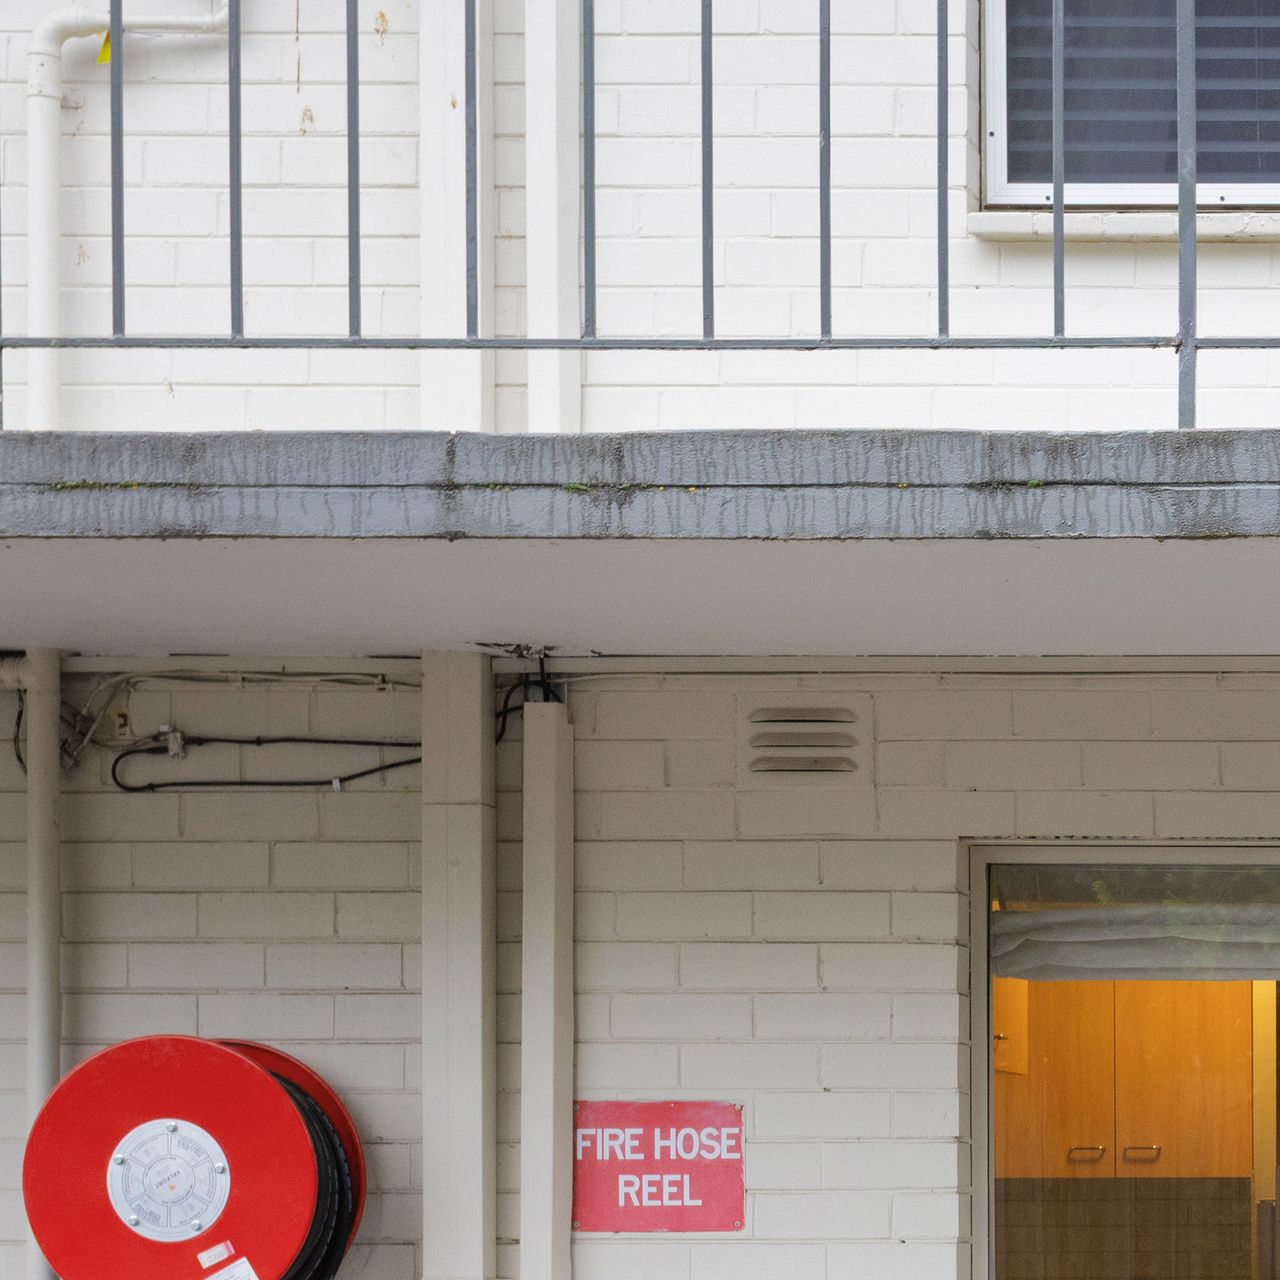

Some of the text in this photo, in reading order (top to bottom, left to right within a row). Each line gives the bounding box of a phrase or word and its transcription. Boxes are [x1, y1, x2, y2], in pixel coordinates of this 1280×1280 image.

[576, 1127, 740, 1160] FIRE HOSE
[618, 1174, 702, 1207] REEL
